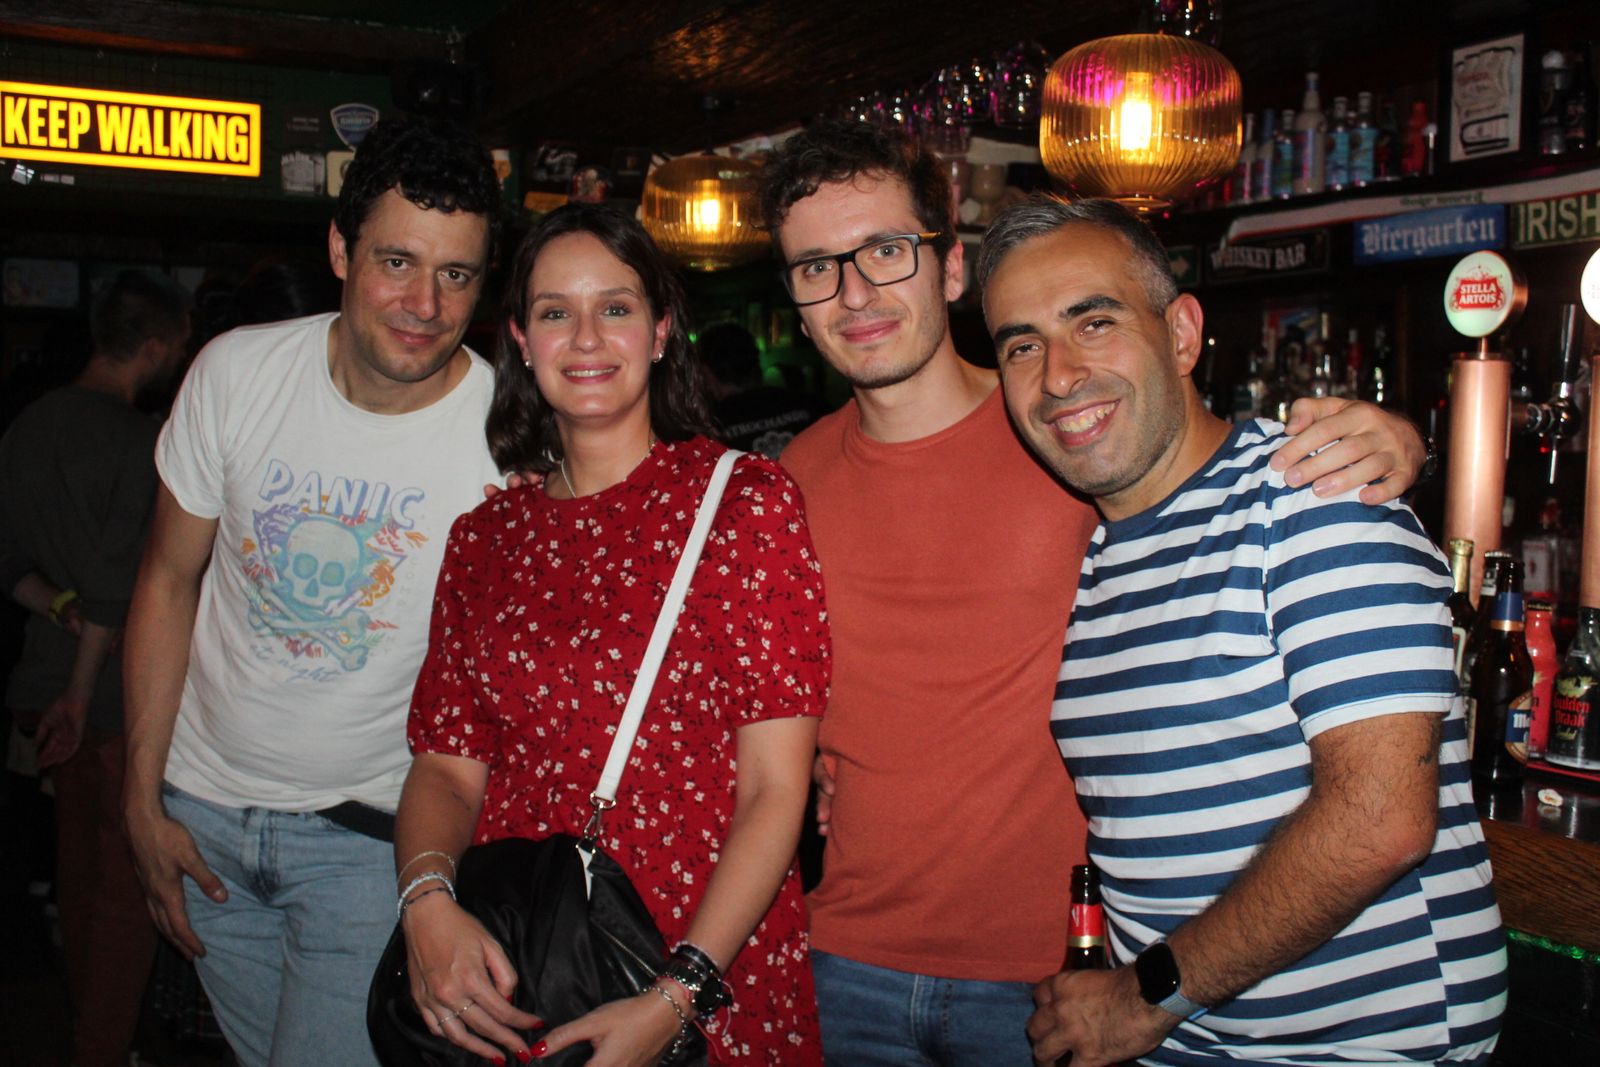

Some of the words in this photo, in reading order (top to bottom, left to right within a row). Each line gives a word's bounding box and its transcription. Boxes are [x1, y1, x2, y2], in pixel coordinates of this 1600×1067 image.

[4, 95, 91, 149] KEEP
[96, 104, 249, 163] WALKING
[1361, 216, 1497, 255] Biergarten
[1518, 193, 1600, 243] IRISH
[1274, 242, 1306, 270] BAR
[1459, 293, 1497, 305] ARTOIS
[1460, 282, 1497, 294] STELLA
[258, 458, 425, 530] PANIC
